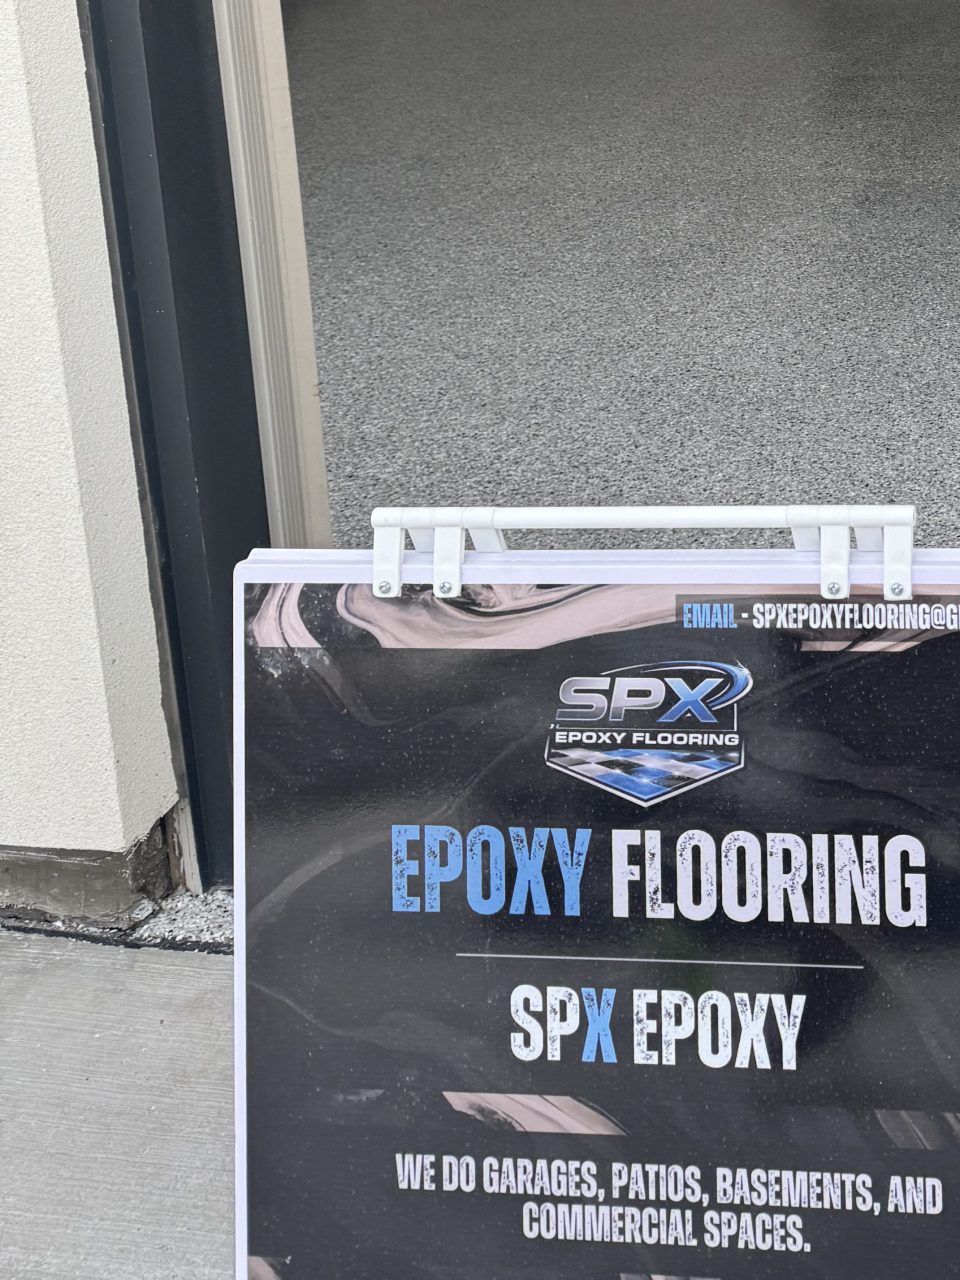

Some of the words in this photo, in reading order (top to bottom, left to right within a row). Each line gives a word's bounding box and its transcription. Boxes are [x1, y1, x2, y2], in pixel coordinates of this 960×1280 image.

[682, 602, 738, 629] EMAIL
[555, 676, 724, 723] SPX
[555, 731, 627, 744] EPOXY
[632, 732, 740, 746] FLOORING
[391, 824, 592, 916] EPOXY
[611, 829, 927, 927] FLOORING
[510, 984, 618, 1063] SPX
[632, 989, 807, 1071] EPOXY
[395, 1153, 436, 1191] WE
[442, 1155, 476, 1193] DO
[482, 1156, 605, 1202] GARAGES,
[611, 1162, 709, 1207] PATIOS,
[716, 1167, 881, 1216] BASEMENTS,
[887, 1175, 943, 1215] AND
[522, 1201, 698, 1247] COMMERCIAL
[703, 1210, 811, 1253] SPACES.
